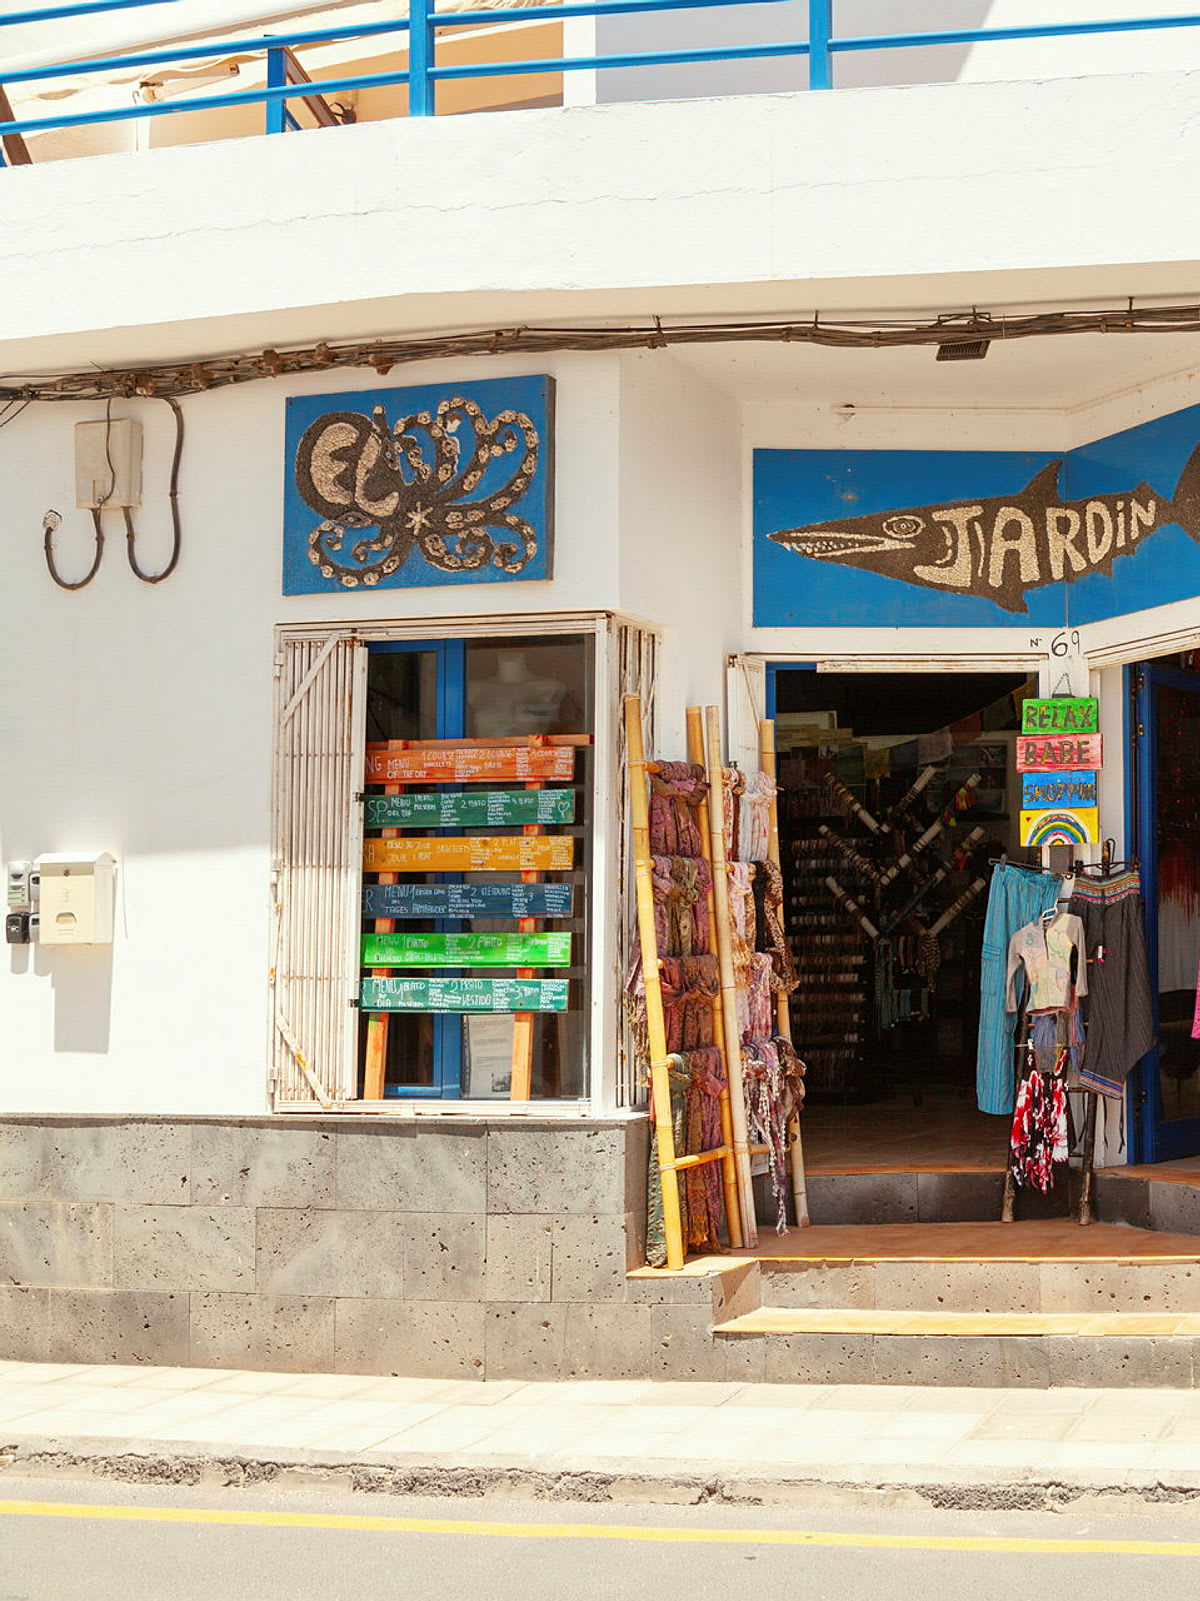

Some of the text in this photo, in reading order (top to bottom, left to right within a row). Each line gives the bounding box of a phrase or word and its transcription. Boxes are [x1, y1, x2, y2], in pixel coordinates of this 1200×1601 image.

[1051, 630, 1080, 657] 69
[1026, 704, 1094, 729] RELAX
[1024, 739, 1091, 766] BABE
[386, 757, 411, 770] MENU
[390, 796, 411, 808] MENU
[460, 799, 469, 809] 2
[384, 884, 410, 898] MENU
[470, 887, 478, 897] 2
[373, 979, 398, 994] MENU
[450, 980, 460, 994] 2
[461, 993, 493, 1007] VESTIDO
